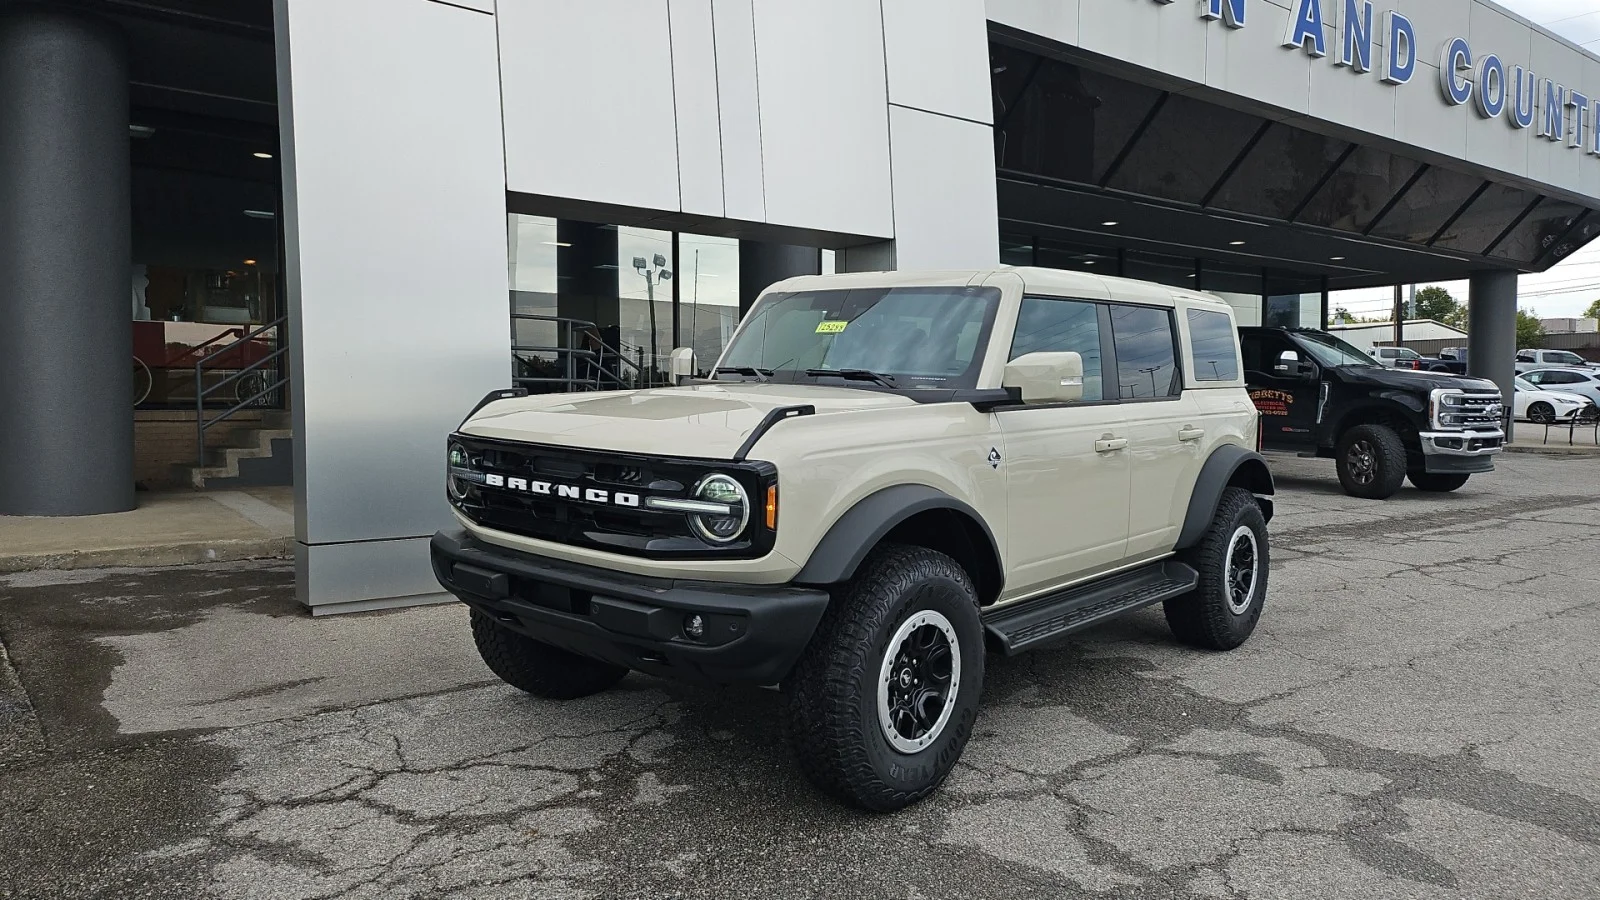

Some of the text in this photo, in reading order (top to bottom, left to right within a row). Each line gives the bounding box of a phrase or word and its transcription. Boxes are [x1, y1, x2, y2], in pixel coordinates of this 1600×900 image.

[1282, 0, 1417, 85] AND
[1249, 390, 1293, 403] IBBETTS
[486, 473, 639, 507] BRONCO
